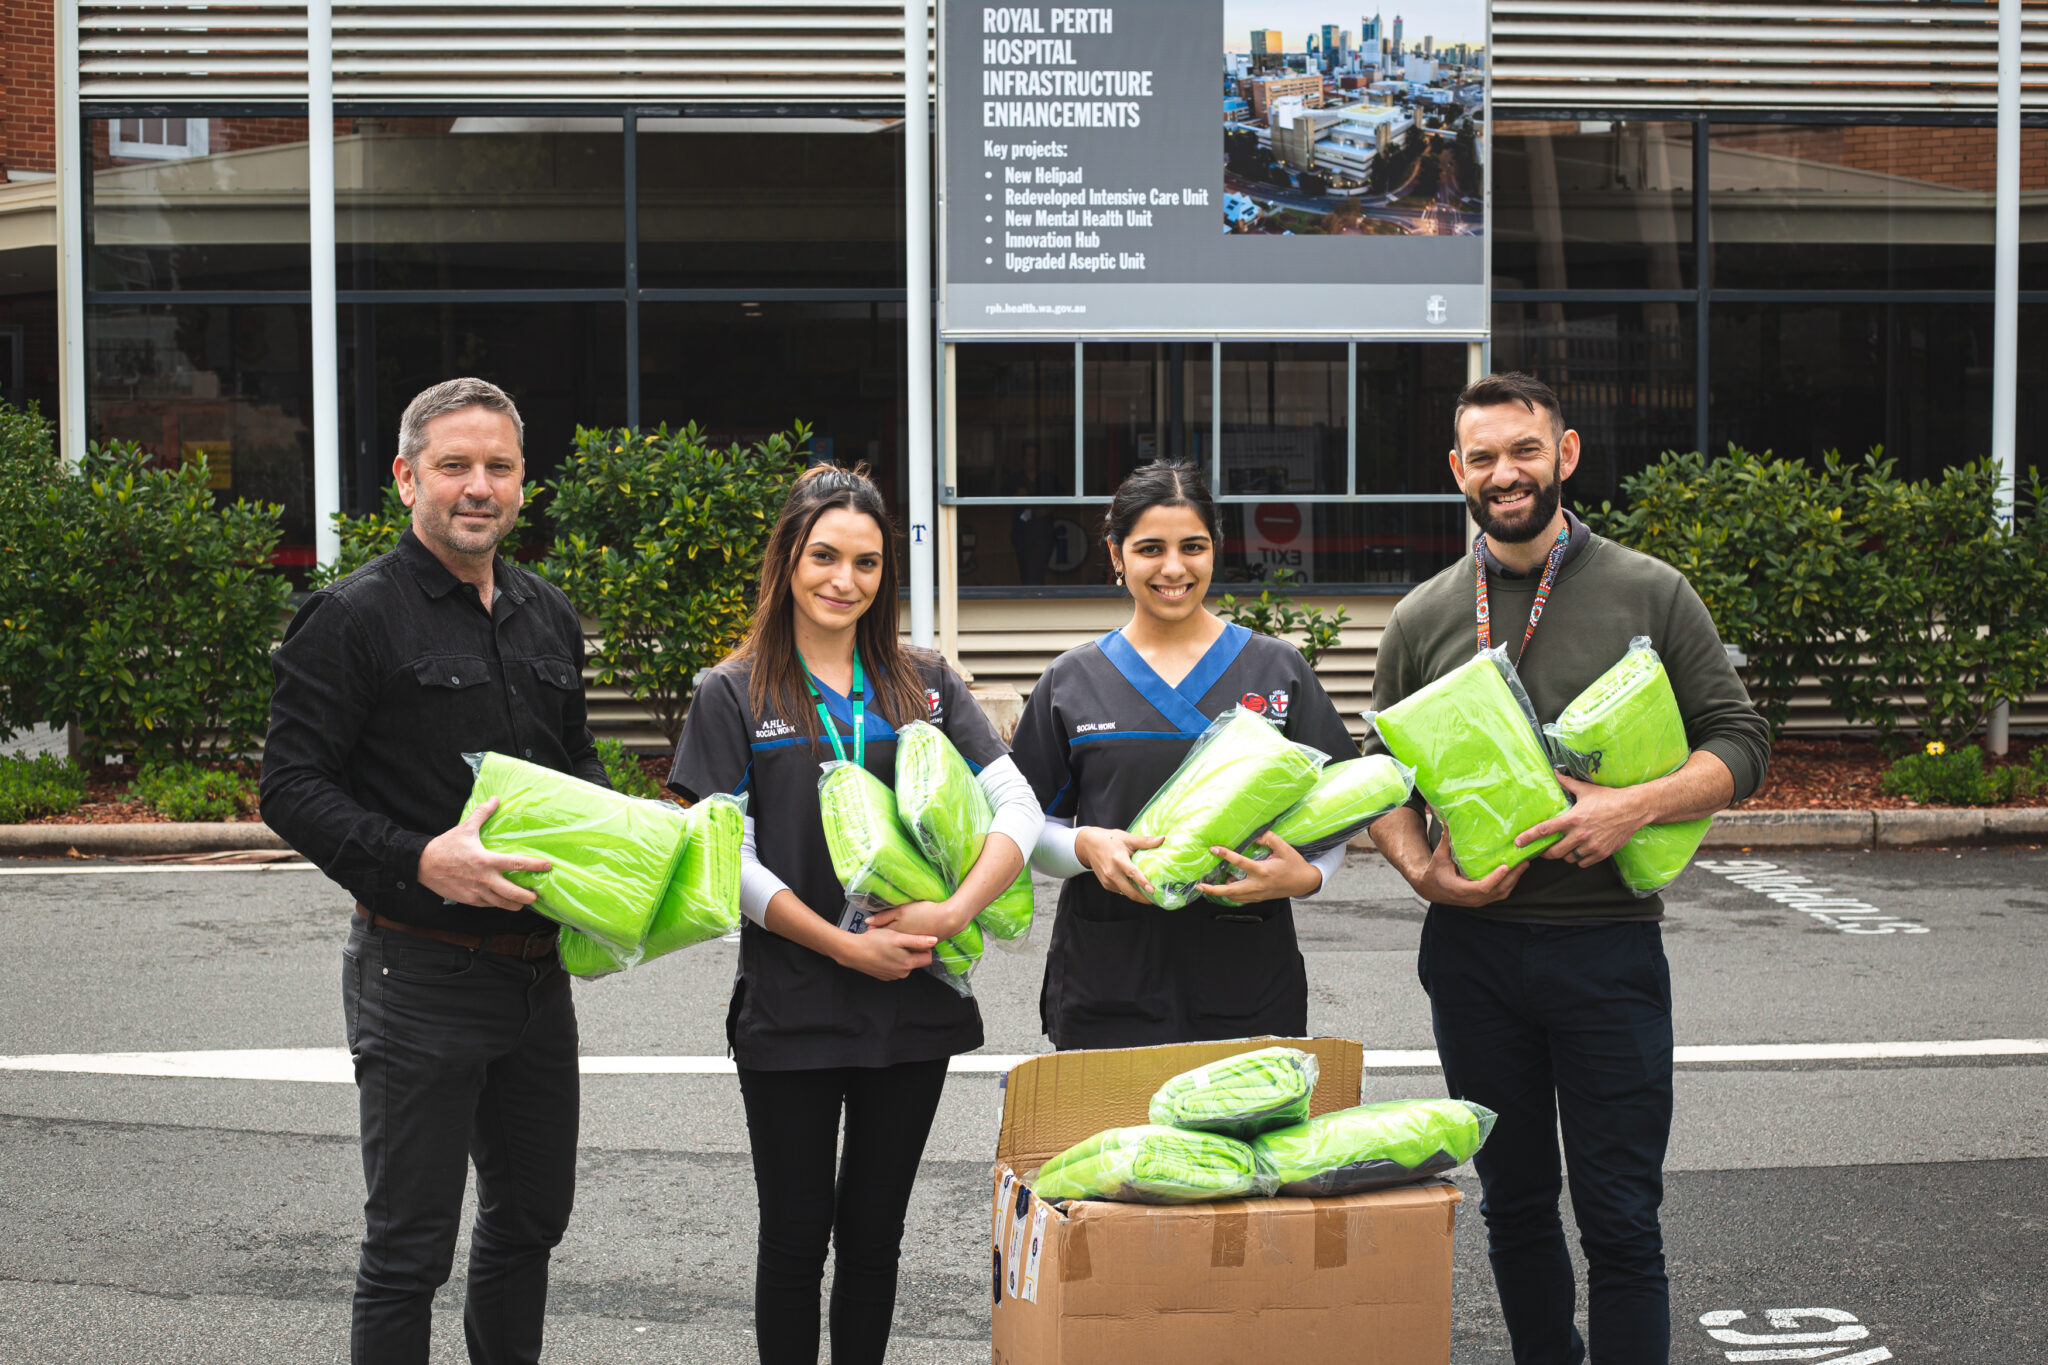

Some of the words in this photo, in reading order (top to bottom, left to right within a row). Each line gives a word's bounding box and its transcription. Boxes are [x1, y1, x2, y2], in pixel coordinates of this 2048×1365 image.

[983, 7, 1045, 34] ROYAL
[1050, 7, 1113, 34] PERTH
[983, 38, 1077, 65] HOSPITAL
[983, 70, 1154, 97] INFRASTRUCTURE
[983, 101, 1141, 128] ENHANCEMENTS
[984, 140, 1009, 161] Key
[1011, 140, 1068, 161] projects:
[1005, 167, 1033, 184] New
[1035, 167, 1083, 187] Helipad
[1005, 188, 1086, 209] Redeveloped
[1089, 188, 1147, 206] Intensive
[1149, 188, 1180, 206] Care
[1182, 188, 1209, 206] Unit
[1005, 210, 1033, 227] New
[1035, 210, 1079, 227] Mental
[1082, 210, 1124, 227] Health
[1126, 210, 1153, 227] Unit
[1005, 231, 1072, 249] Innovation
[1075, 231, 1101, 249] Hub
[1005, 252, 1066, 273] Upgraded
[1068, 252, 1117, 273] Aseptic
[1119, 252, 1146, 270] Unit
[985, 303, 1087, 315] rph.health.wa.gov.au
[755, 729, 777, 738] SOCIAL
[1076, 723, 1098, 733] SOCIAL
[1098, 721, 1116, 731] WORK
[1694, 860, 1931, 935] STOPPING
